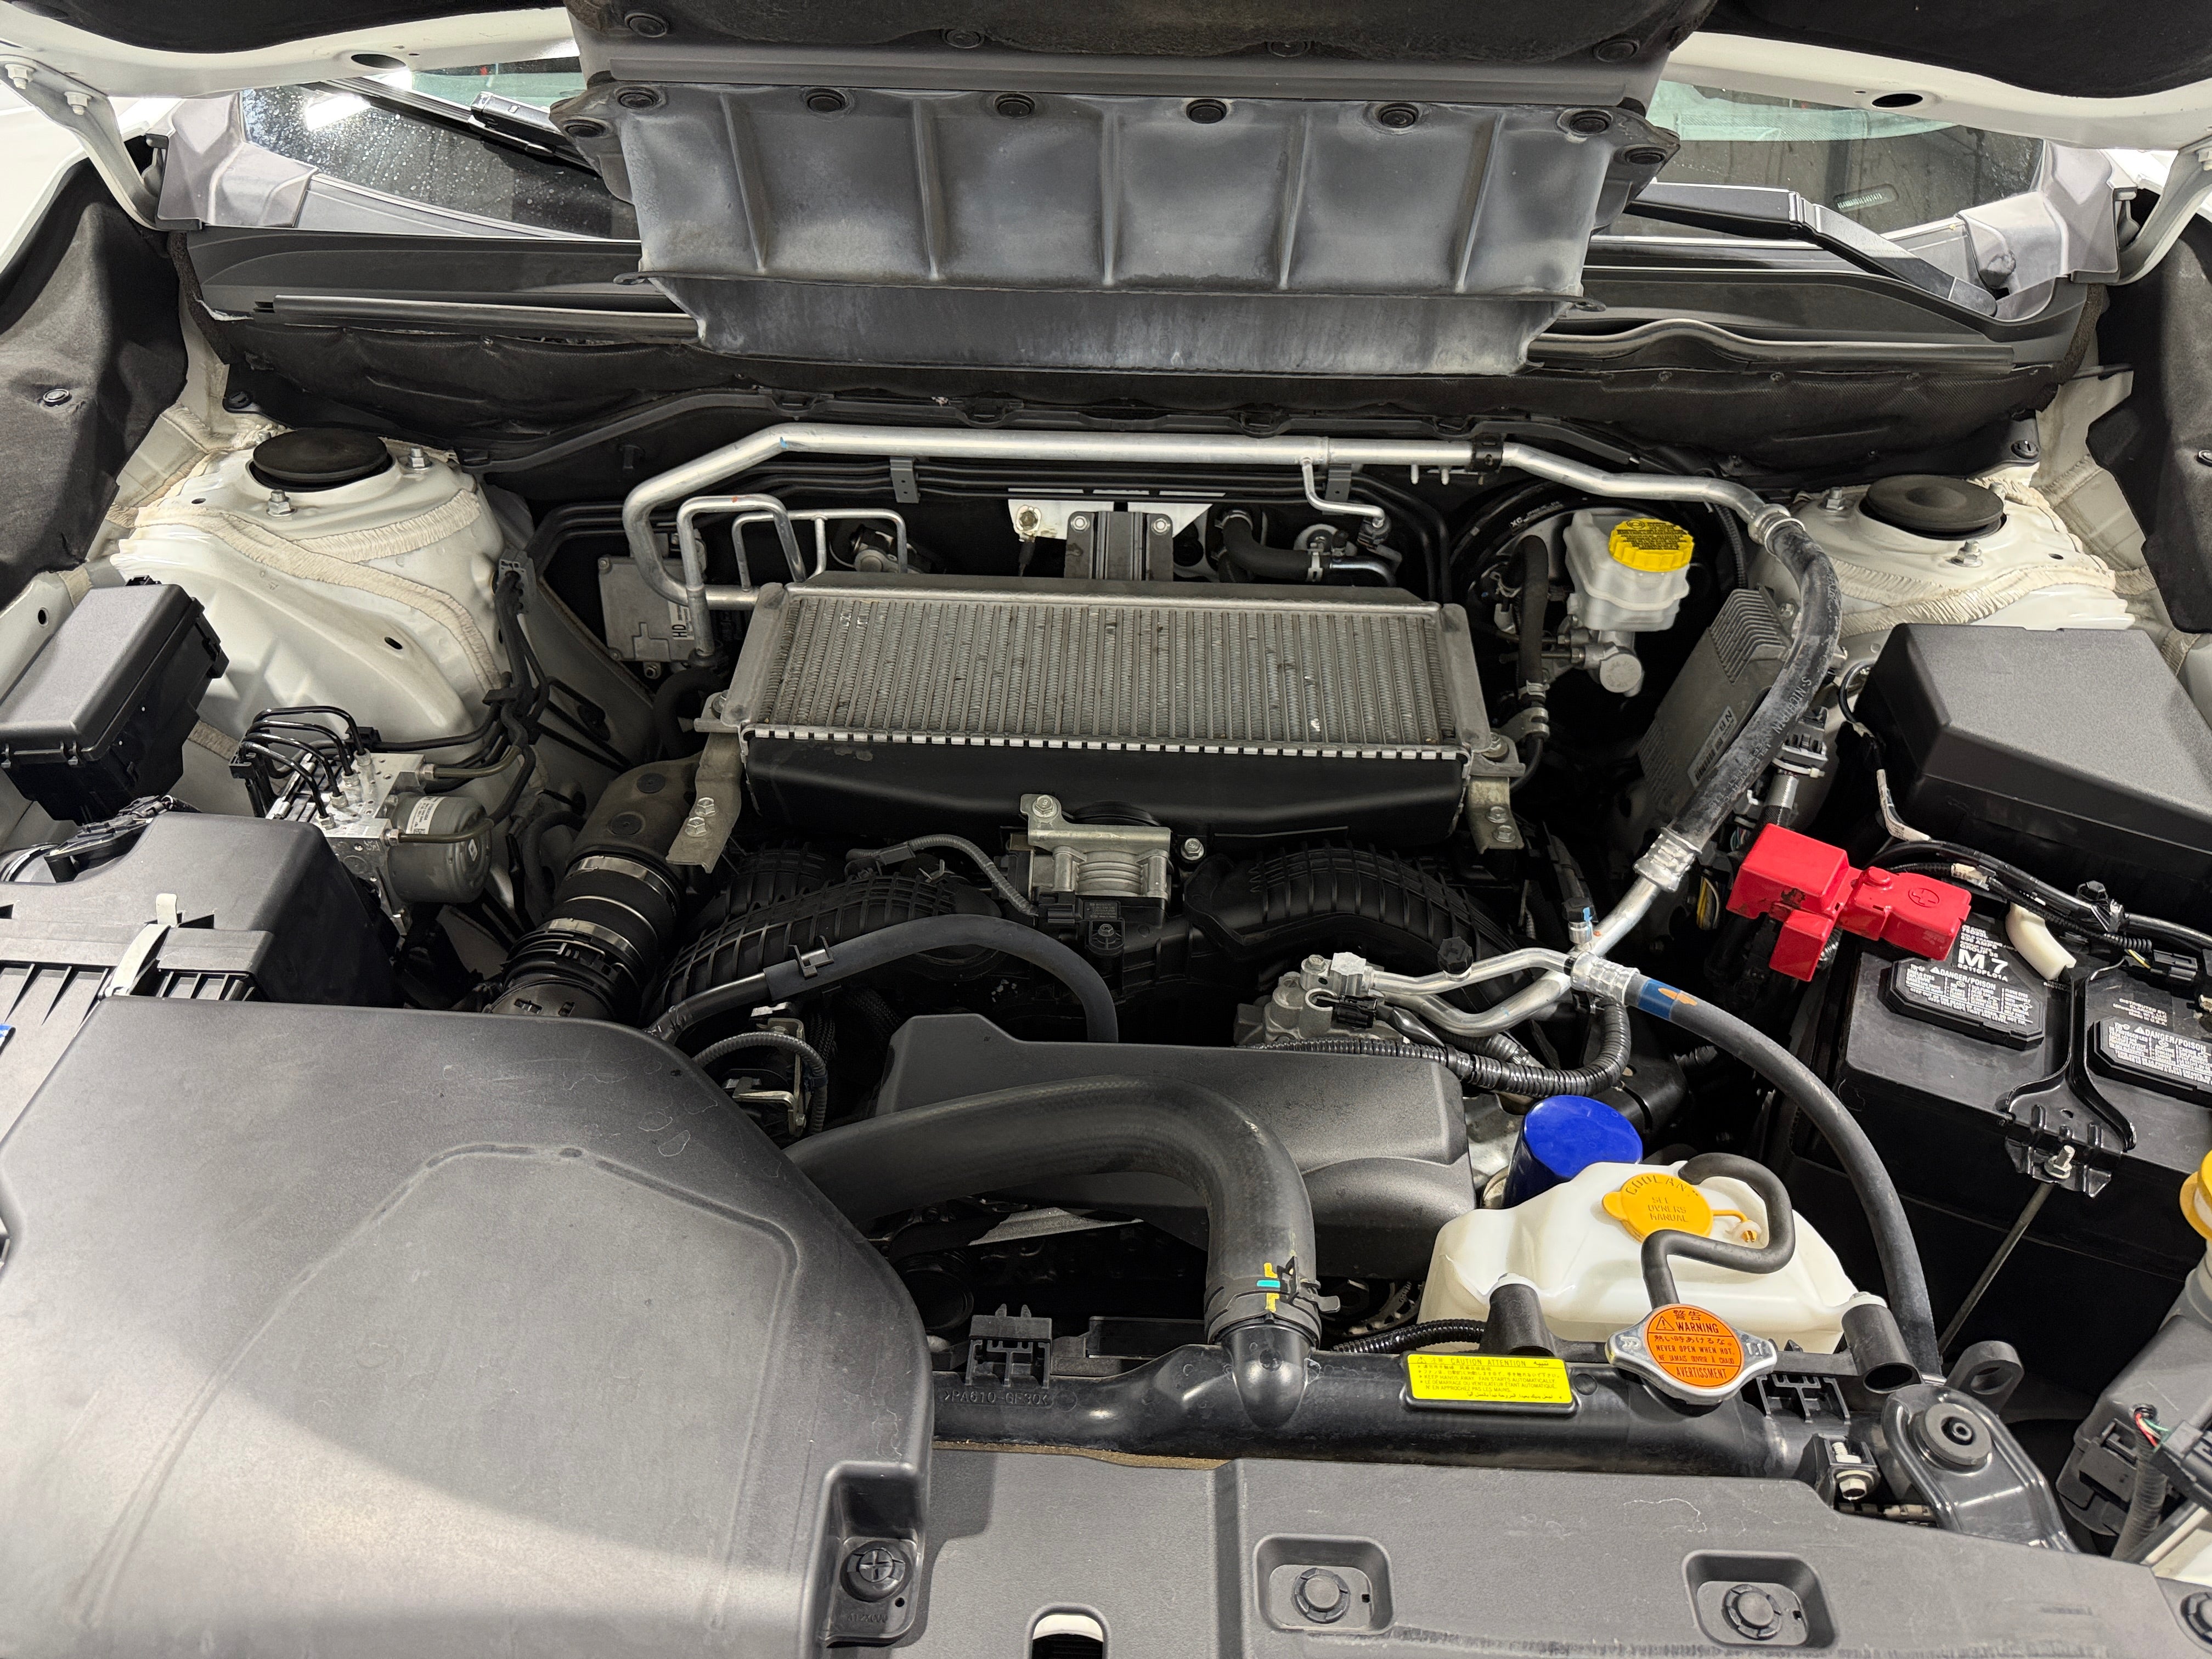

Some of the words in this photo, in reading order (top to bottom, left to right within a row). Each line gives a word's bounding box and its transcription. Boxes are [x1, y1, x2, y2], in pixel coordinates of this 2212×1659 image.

[672, 624, 687, 637] HD
[1960, 944, 1988, 954] GROUP
[1939, 969, 1996, 991] DANGER/POISON
[2144, 1029, 2207, 1053] DANGER/POISON
[1626, 1175, 1699, 1197] COOLAN
[1650, 1212, 1689, 1222] MANUAL
[1673, 1310, 1701, 1321] 警告
[1675, 1322, 1719, 1334] WARNING
[1487, 1359, 1526, 1367] ATTENTION
